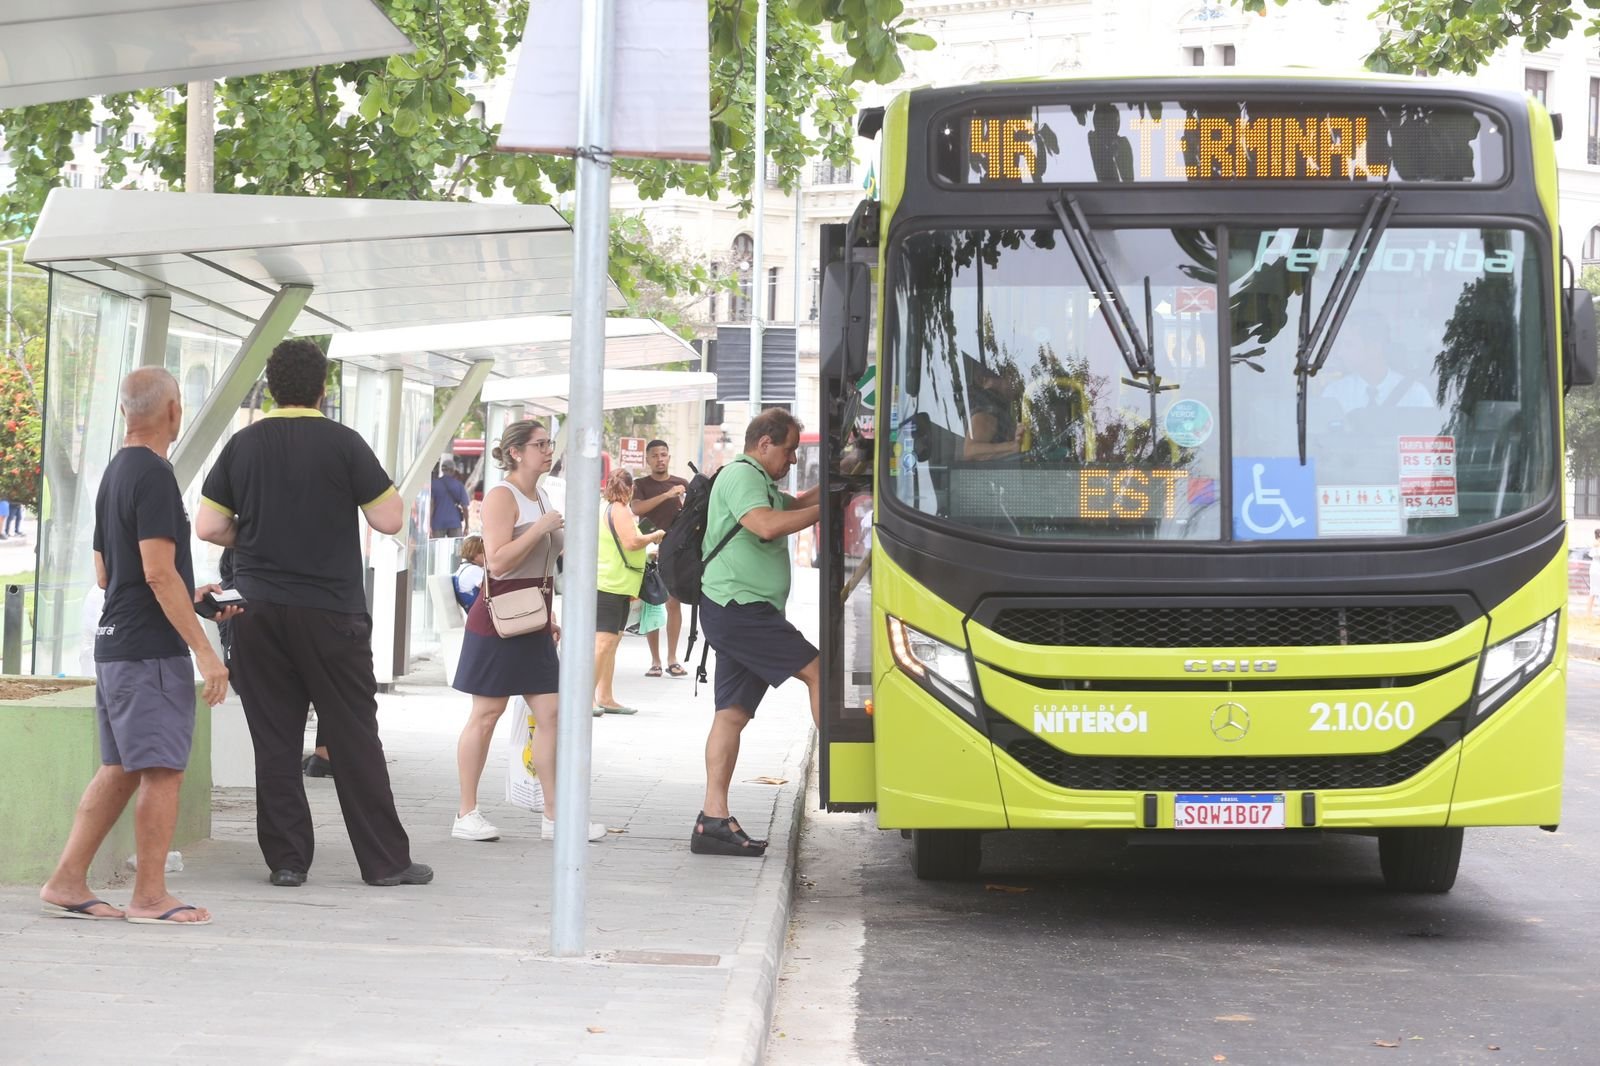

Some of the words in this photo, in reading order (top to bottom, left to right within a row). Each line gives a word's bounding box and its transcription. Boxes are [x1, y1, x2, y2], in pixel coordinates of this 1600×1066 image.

[970, 118, 1036, 179] 46
[1130, 117, 1389, 178] TERMINAL
[1170, 410, 1196, 418] VERDE
[1080, 469, 1189, 518] EST
[1426, 497, 1453, 508] 4,45
[1184, 659, 1278, 673] CAIO
[1033, 704, 1088, 712] CIDADE
[1099, 704, 1115, 712] DE
[1033, 704, 1148, 733] NITERÓI
[1184, 805, 1273, 825] SQW1B07
